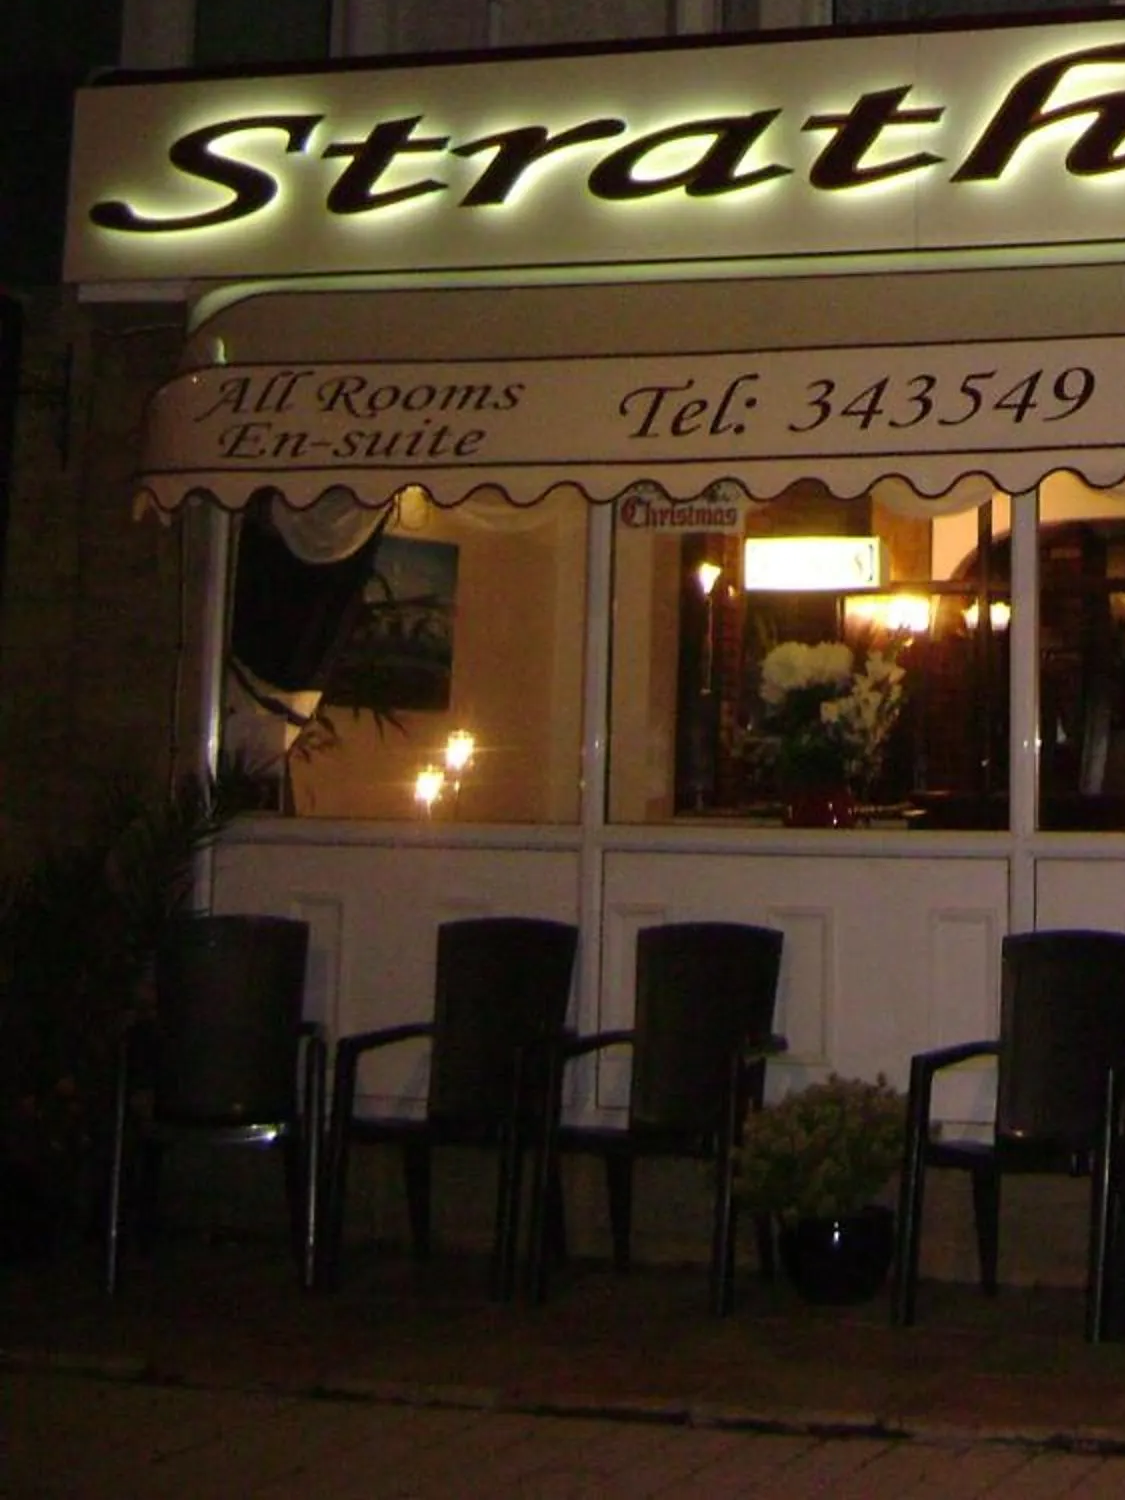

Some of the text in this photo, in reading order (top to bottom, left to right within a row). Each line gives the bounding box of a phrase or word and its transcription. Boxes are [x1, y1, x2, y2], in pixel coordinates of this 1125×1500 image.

[194, 371, 525, 422] All Rooms
[619, 366, 1096, 438] Tel: 343549
[218, 418, 485, 459] En-suite
[621, 494, 738, 528] Christmas
